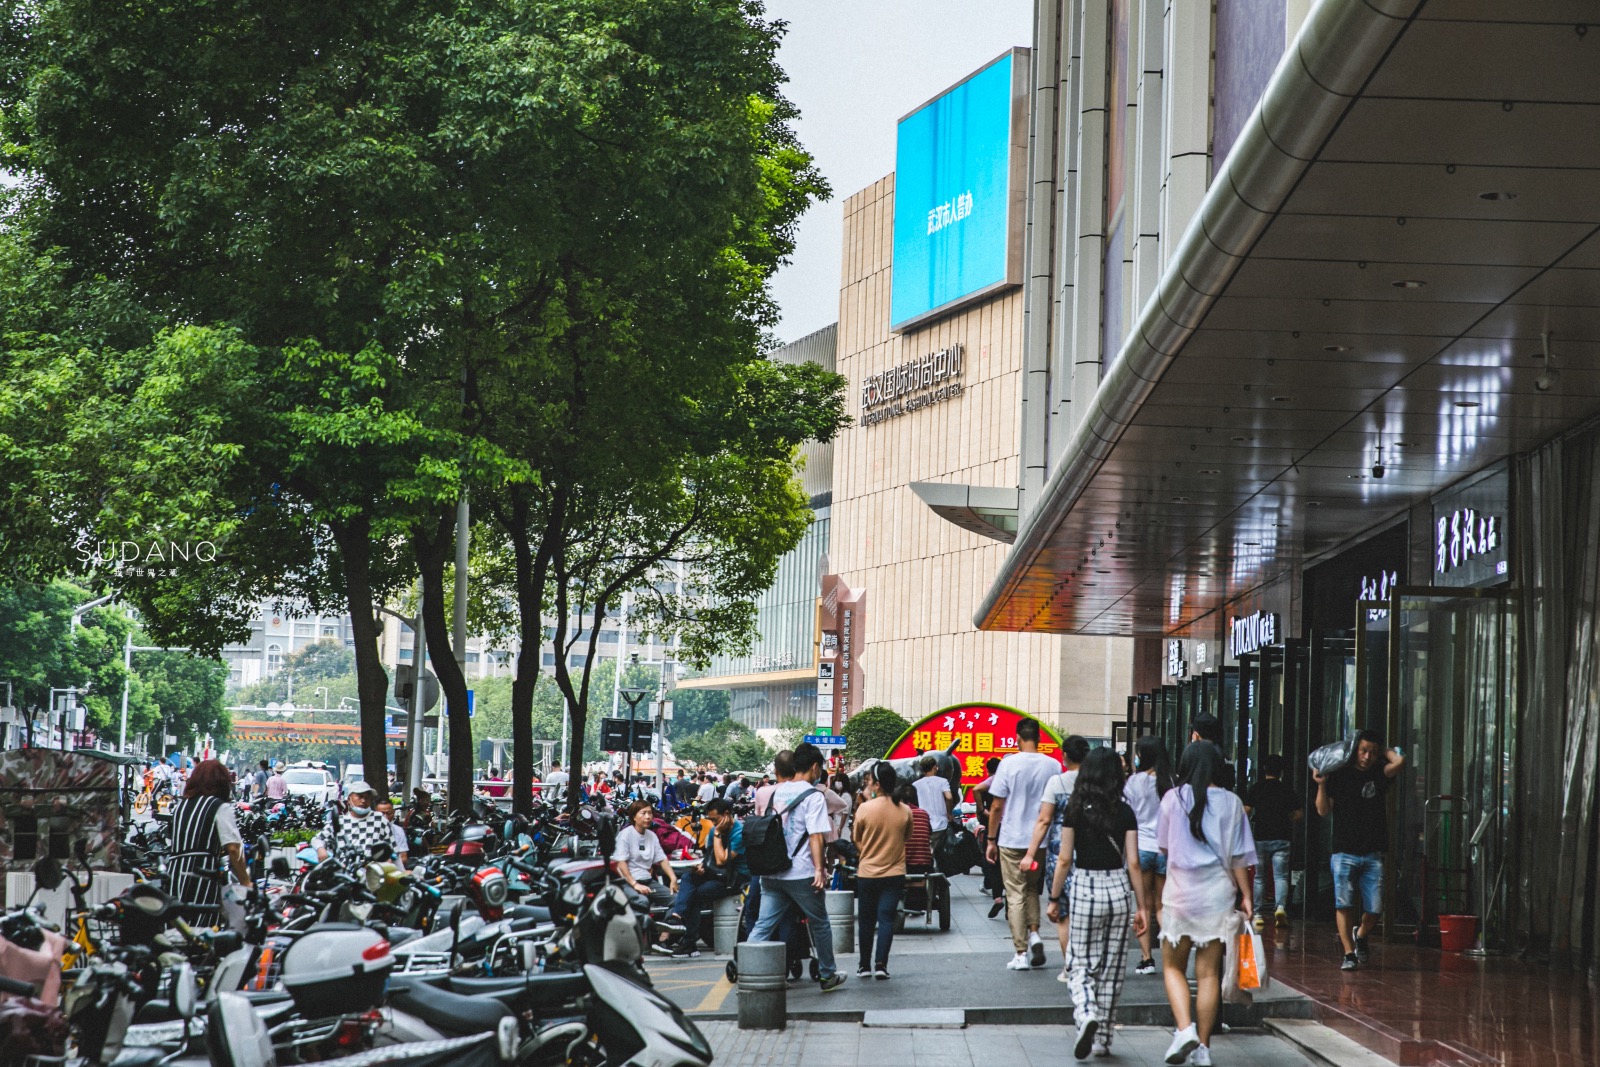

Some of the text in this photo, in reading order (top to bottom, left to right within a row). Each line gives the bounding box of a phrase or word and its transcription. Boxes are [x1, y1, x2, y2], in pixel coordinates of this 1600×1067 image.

[861, 343, 963, 410] 武汉国际时尚中心
[860, 382, 961, 428] INTERNATIONAL FASHION CENTER
[912, 730, 1019, 754] 祝福祖国 194
